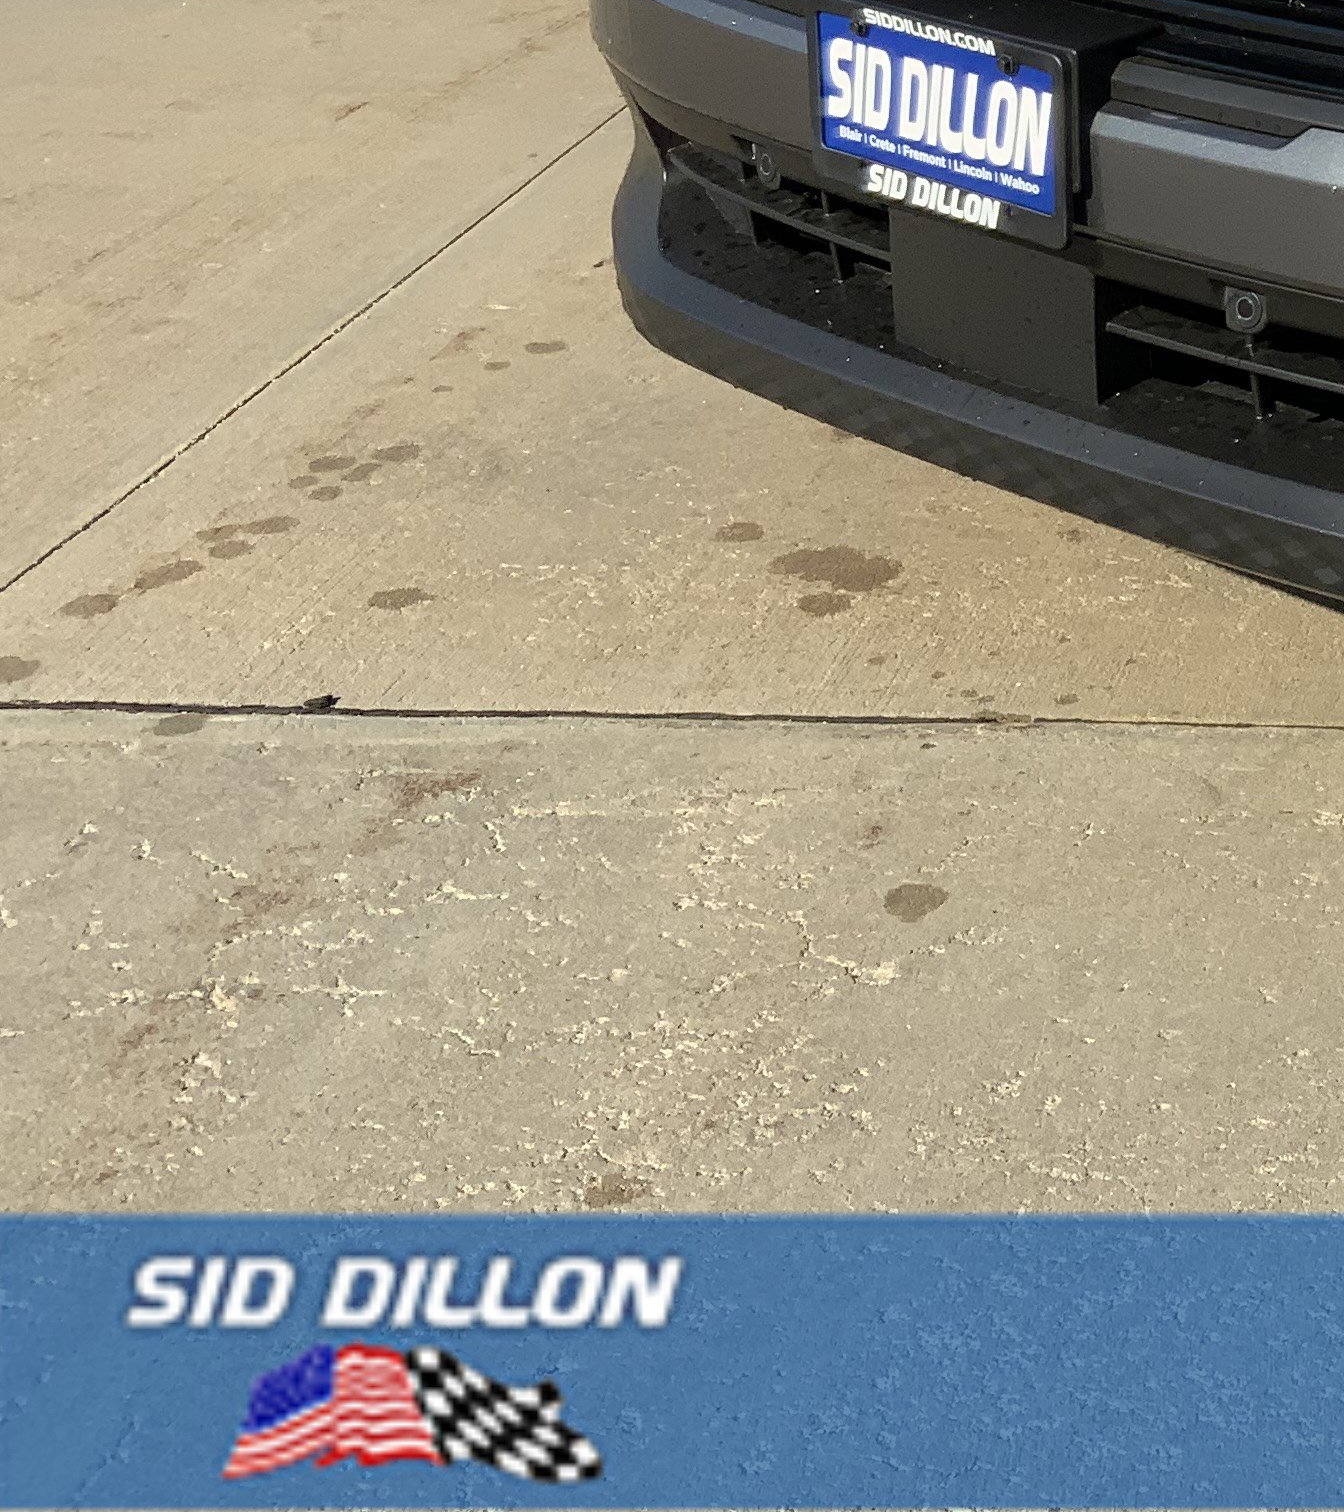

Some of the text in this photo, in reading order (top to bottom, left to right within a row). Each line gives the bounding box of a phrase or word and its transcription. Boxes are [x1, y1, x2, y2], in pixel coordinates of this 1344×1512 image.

[862, 8, 996, 57] SIDDILLON.COM
[827, 38, 1053, 177] SID DILLON
[839, 125, 1041, 195] Blair Crete Fremont Lincoln Wahoo
[867, 163, 1000, 229] SID DILLON
